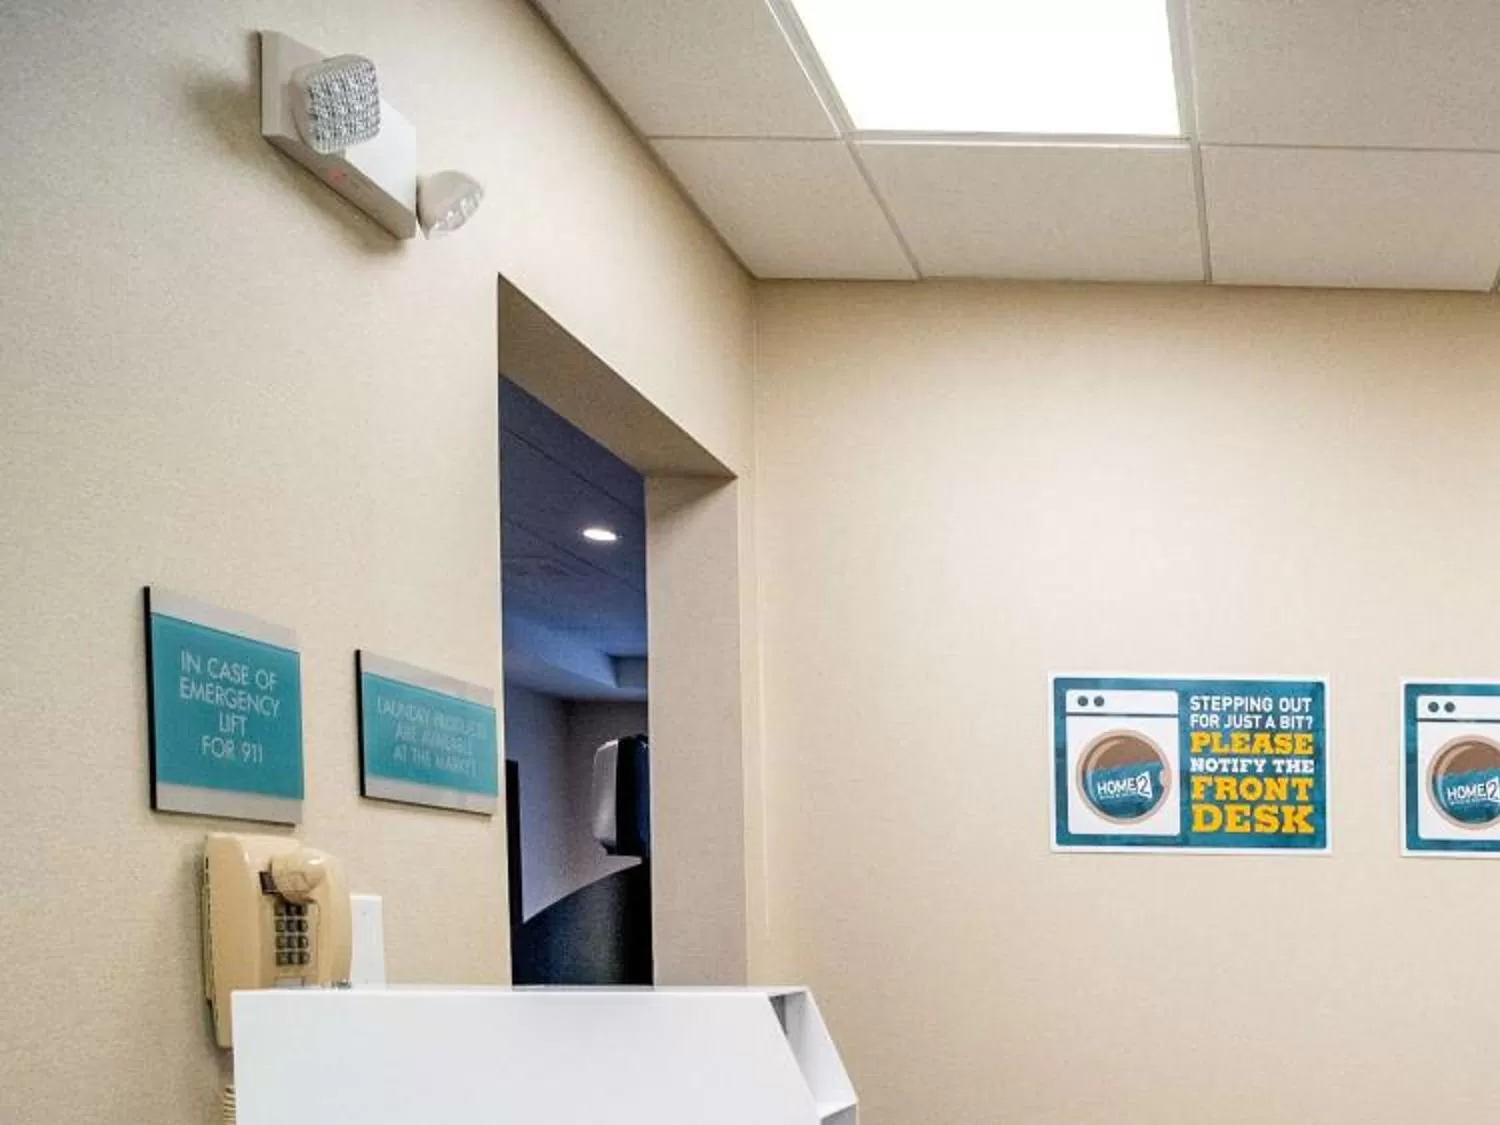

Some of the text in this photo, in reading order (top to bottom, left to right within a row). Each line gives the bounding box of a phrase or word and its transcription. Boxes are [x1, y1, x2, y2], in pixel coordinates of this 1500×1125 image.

[181, 650, 277, 691] IN CASE OF
[180, 676, 280, 716] EMERGENCY
[1189, 696, 1312, 712] STEPPING OUT
[219, 711, 247, 736] LIFT
[1189, 713, 1313, 730] FOR JUST A BIT?
[201, 736, 262, 763] FOR 911
[1190, 732, 1314, 755] PLEASE
[1190, 758, 1315, 773] NOTIFY THE
[1191, 776, 1314, 801] FRONT
[1192, 804, 1314, 833] DESK
